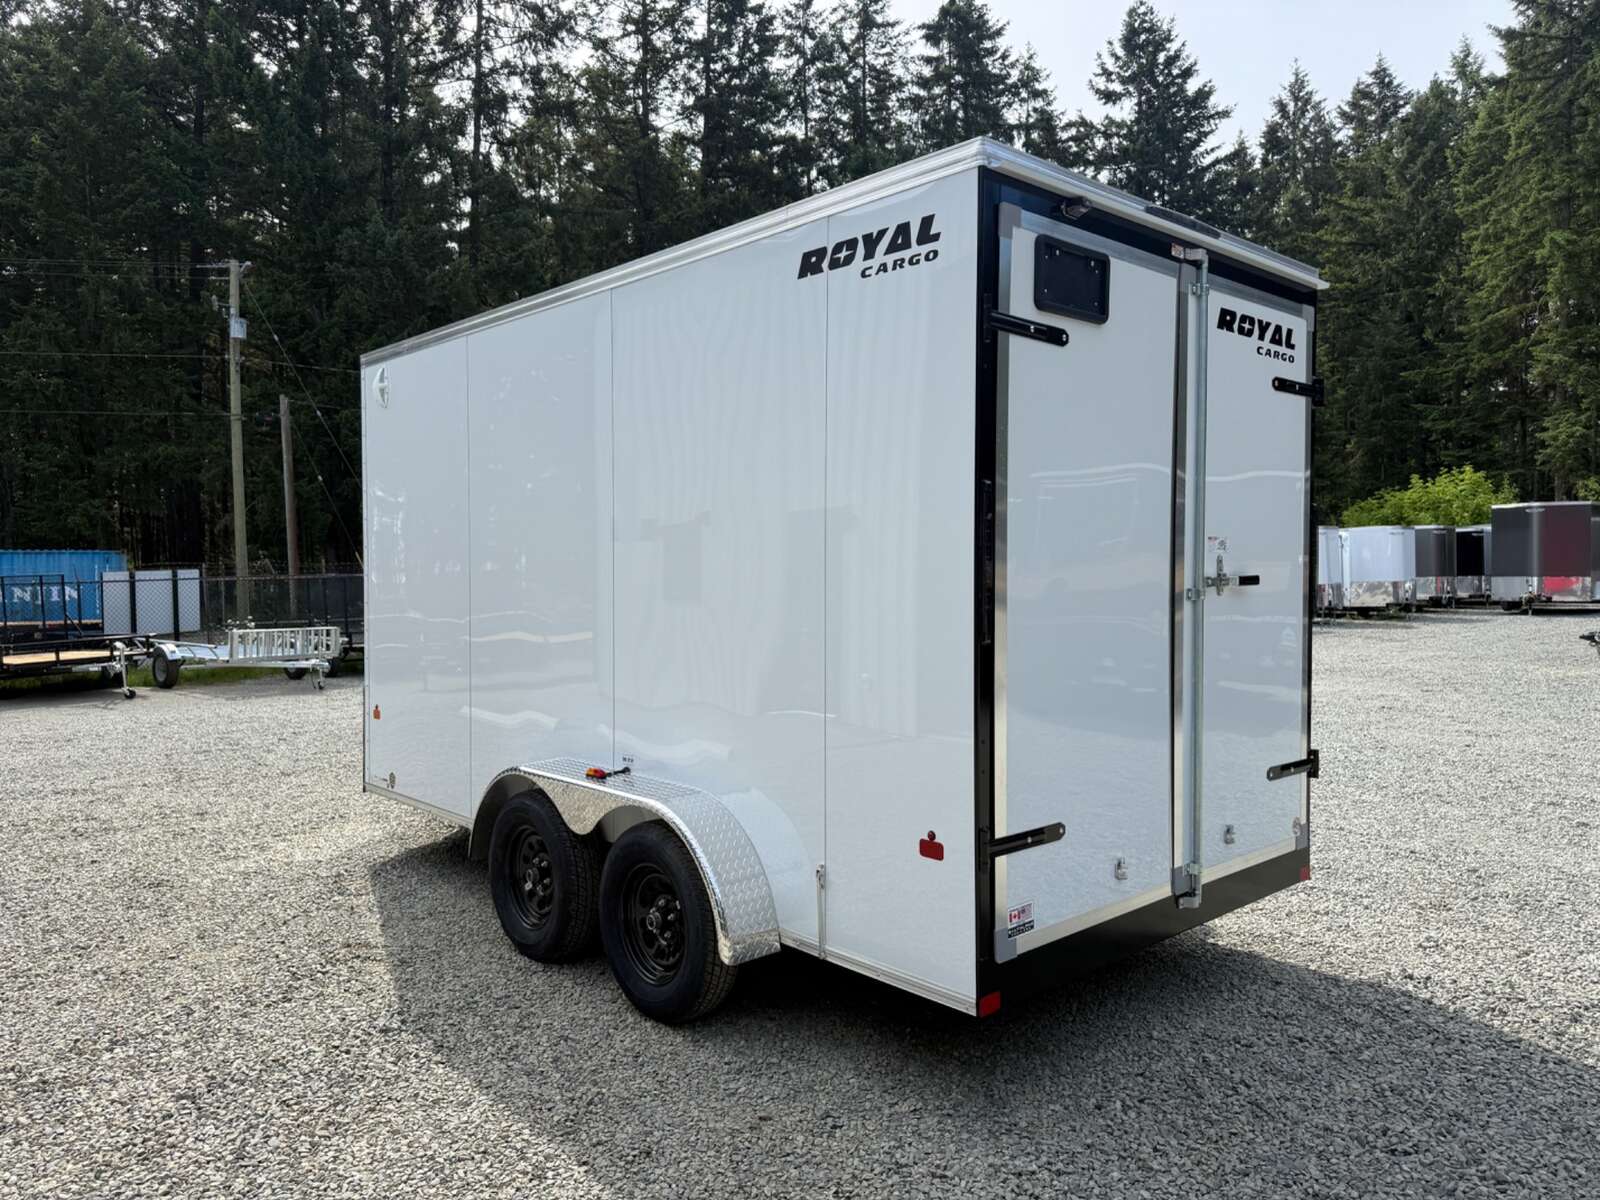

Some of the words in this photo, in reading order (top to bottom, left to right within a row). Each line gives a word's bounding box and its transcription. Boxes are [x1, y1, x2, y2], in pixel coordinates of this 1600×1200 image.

[797, 213, 942, 280] ROYAL
[860, 249, 939, 279] CARGO
[1216, 306, 1296, 351] ROYAL
[1256, 345, 1295, 364] CARGO
